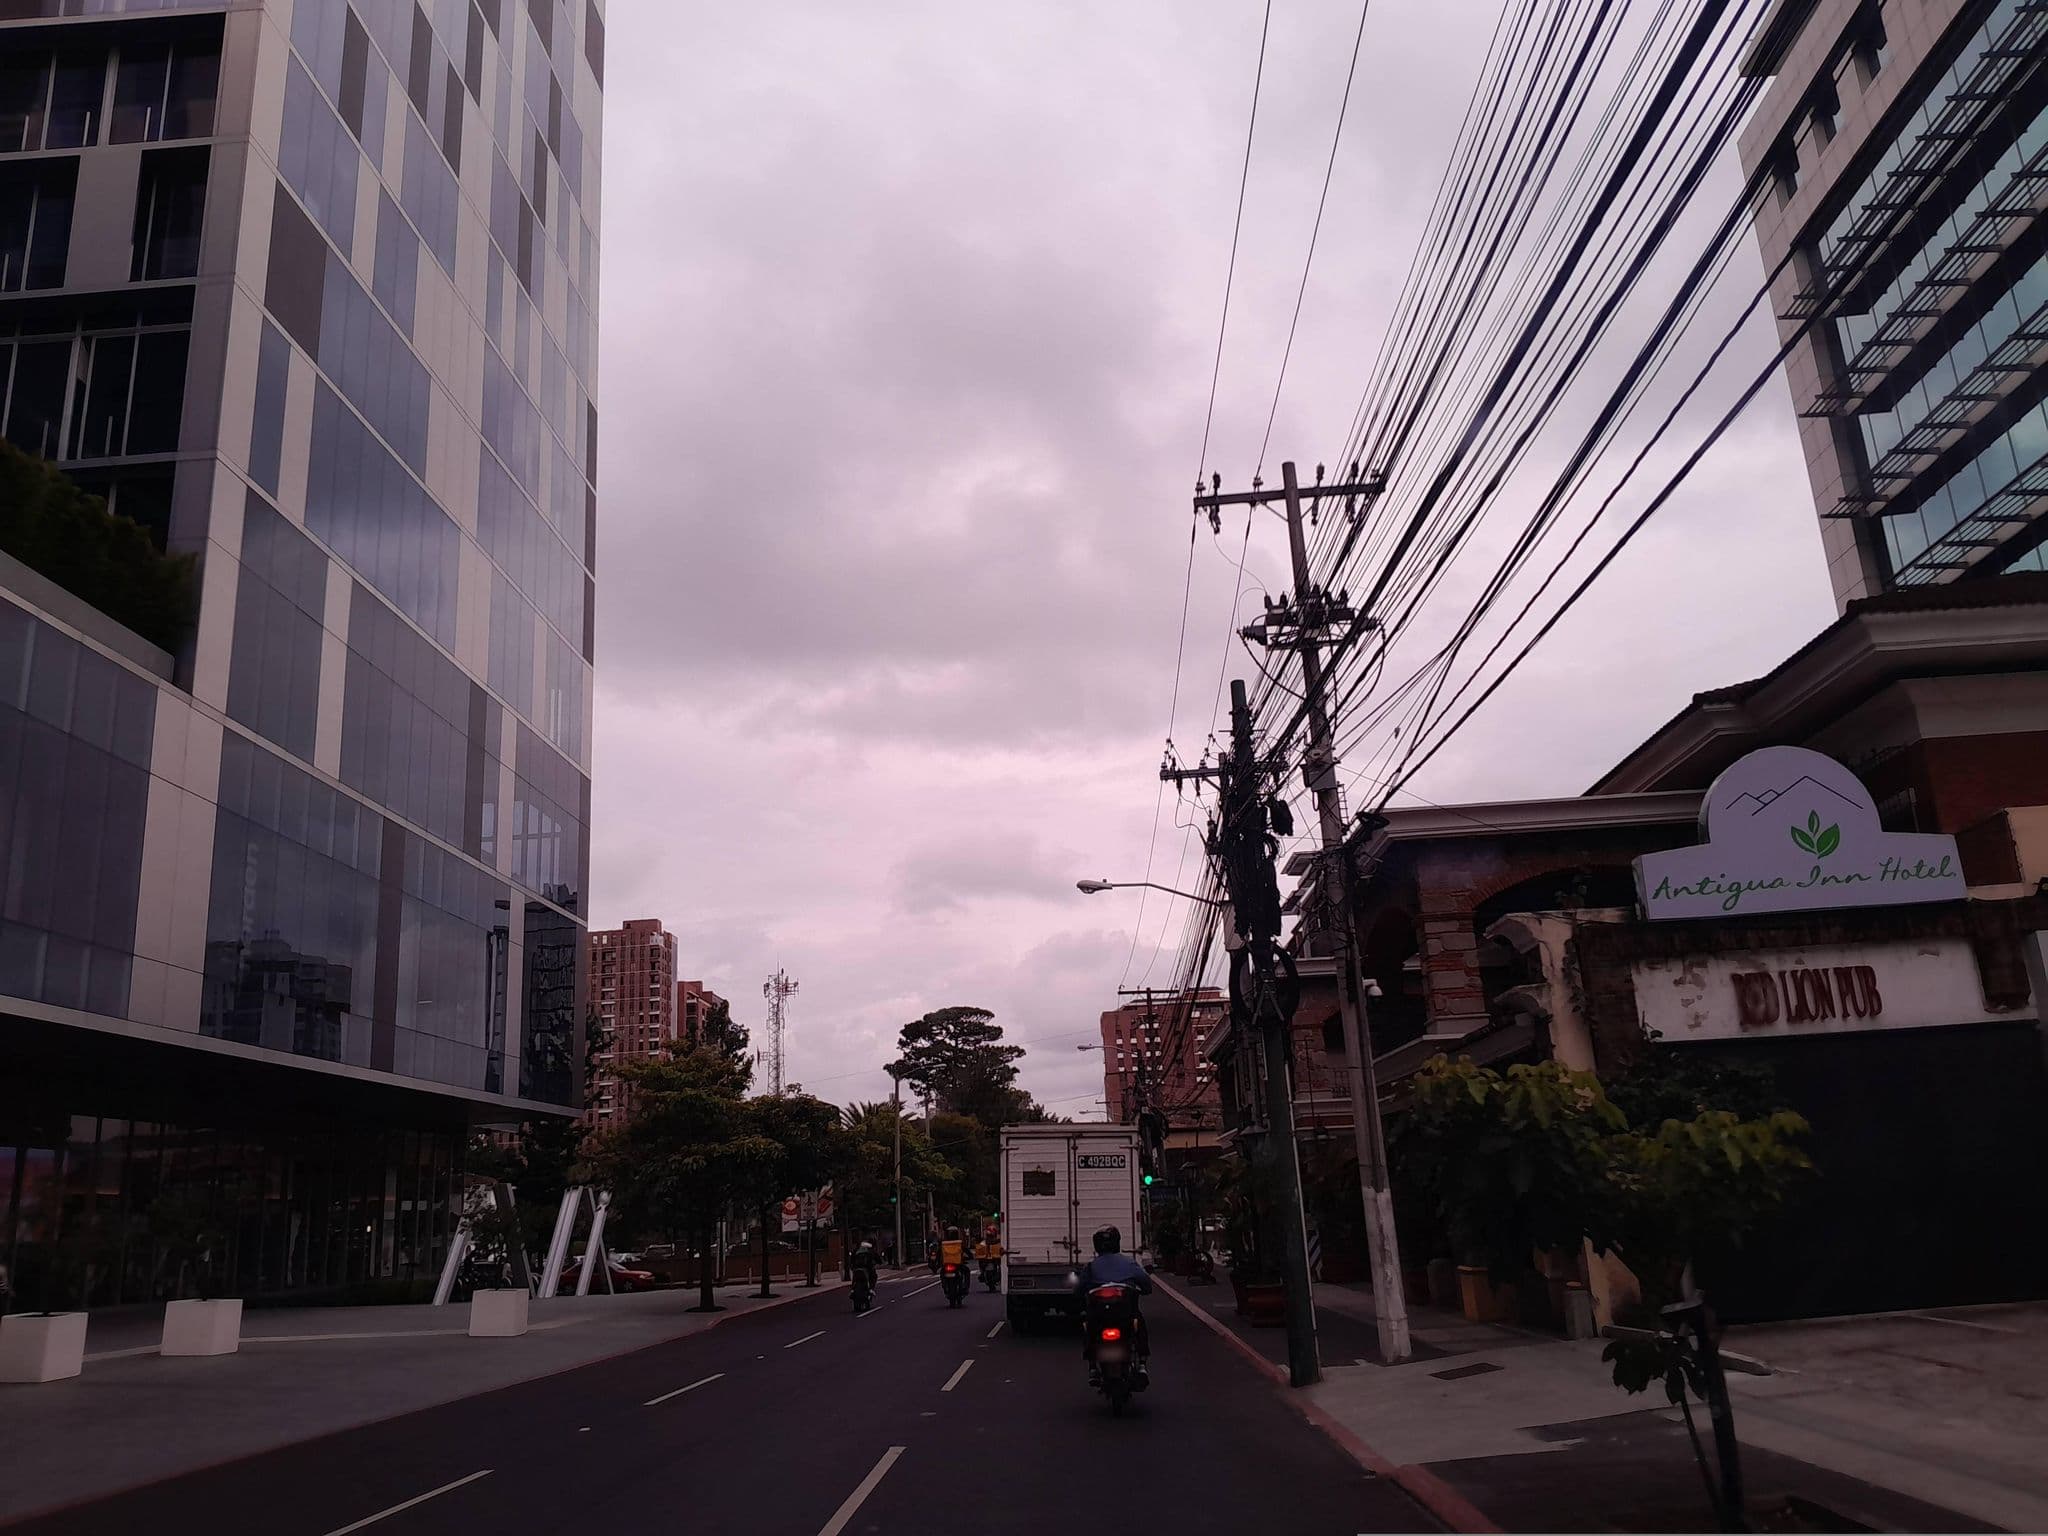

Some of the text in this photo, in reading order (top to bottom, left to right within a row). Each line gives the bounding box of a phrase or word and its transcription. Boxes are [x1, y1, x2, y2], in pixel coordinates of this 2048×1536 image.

[1652, 855, 1956, 911] Antigua Inn Hotel
[1779, 969, 1836, 1024] LION
[1834, 966, 1883, 1018] PUB
